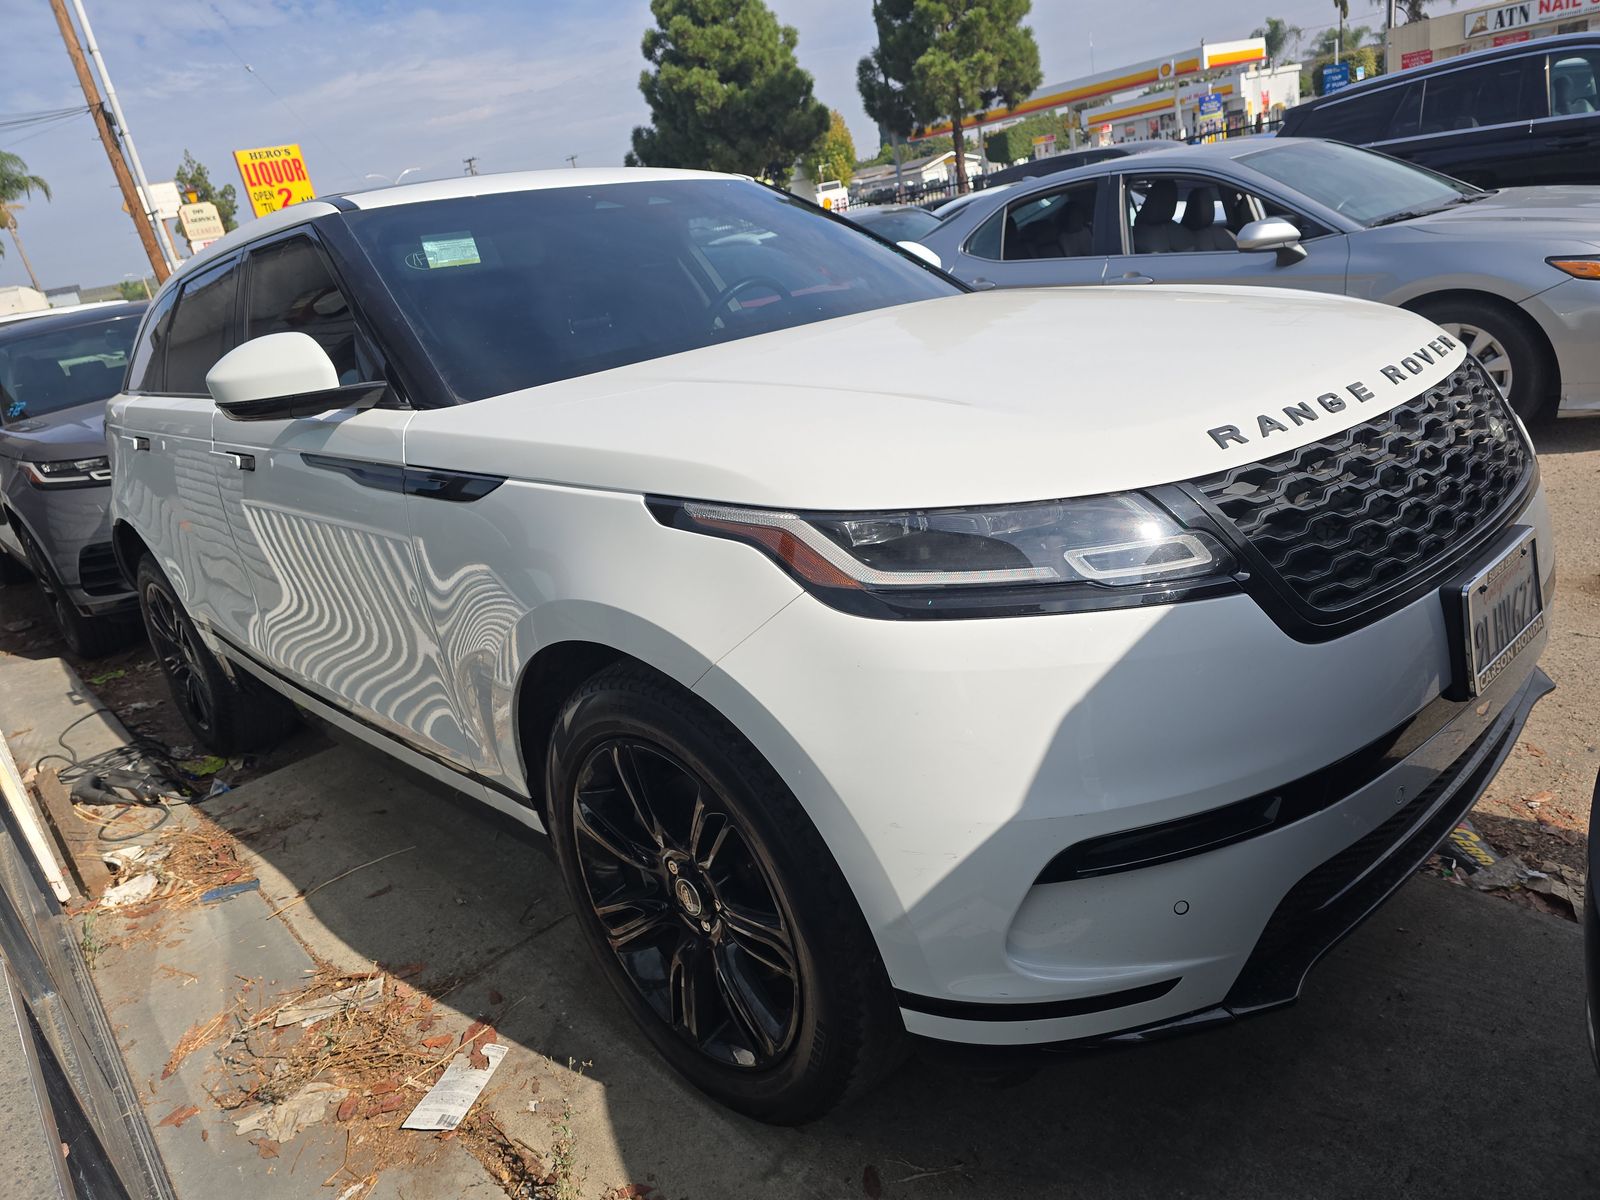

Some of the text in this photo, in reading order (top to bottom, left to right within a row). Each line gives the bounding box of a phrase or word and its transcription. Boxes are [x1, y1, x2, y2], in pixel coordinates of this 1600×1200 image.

[1494, 4, 1531, 29] ATN
[249, 148, 291, 160] HERO'S
[243, 158, 306, 187] LIQUOR
[253, 188, 293, 208] OPEN 2
[1207, 335, 1456, 450] RANGE ROVER
[1480, 615, 1544, 689] CARSON HONDA
